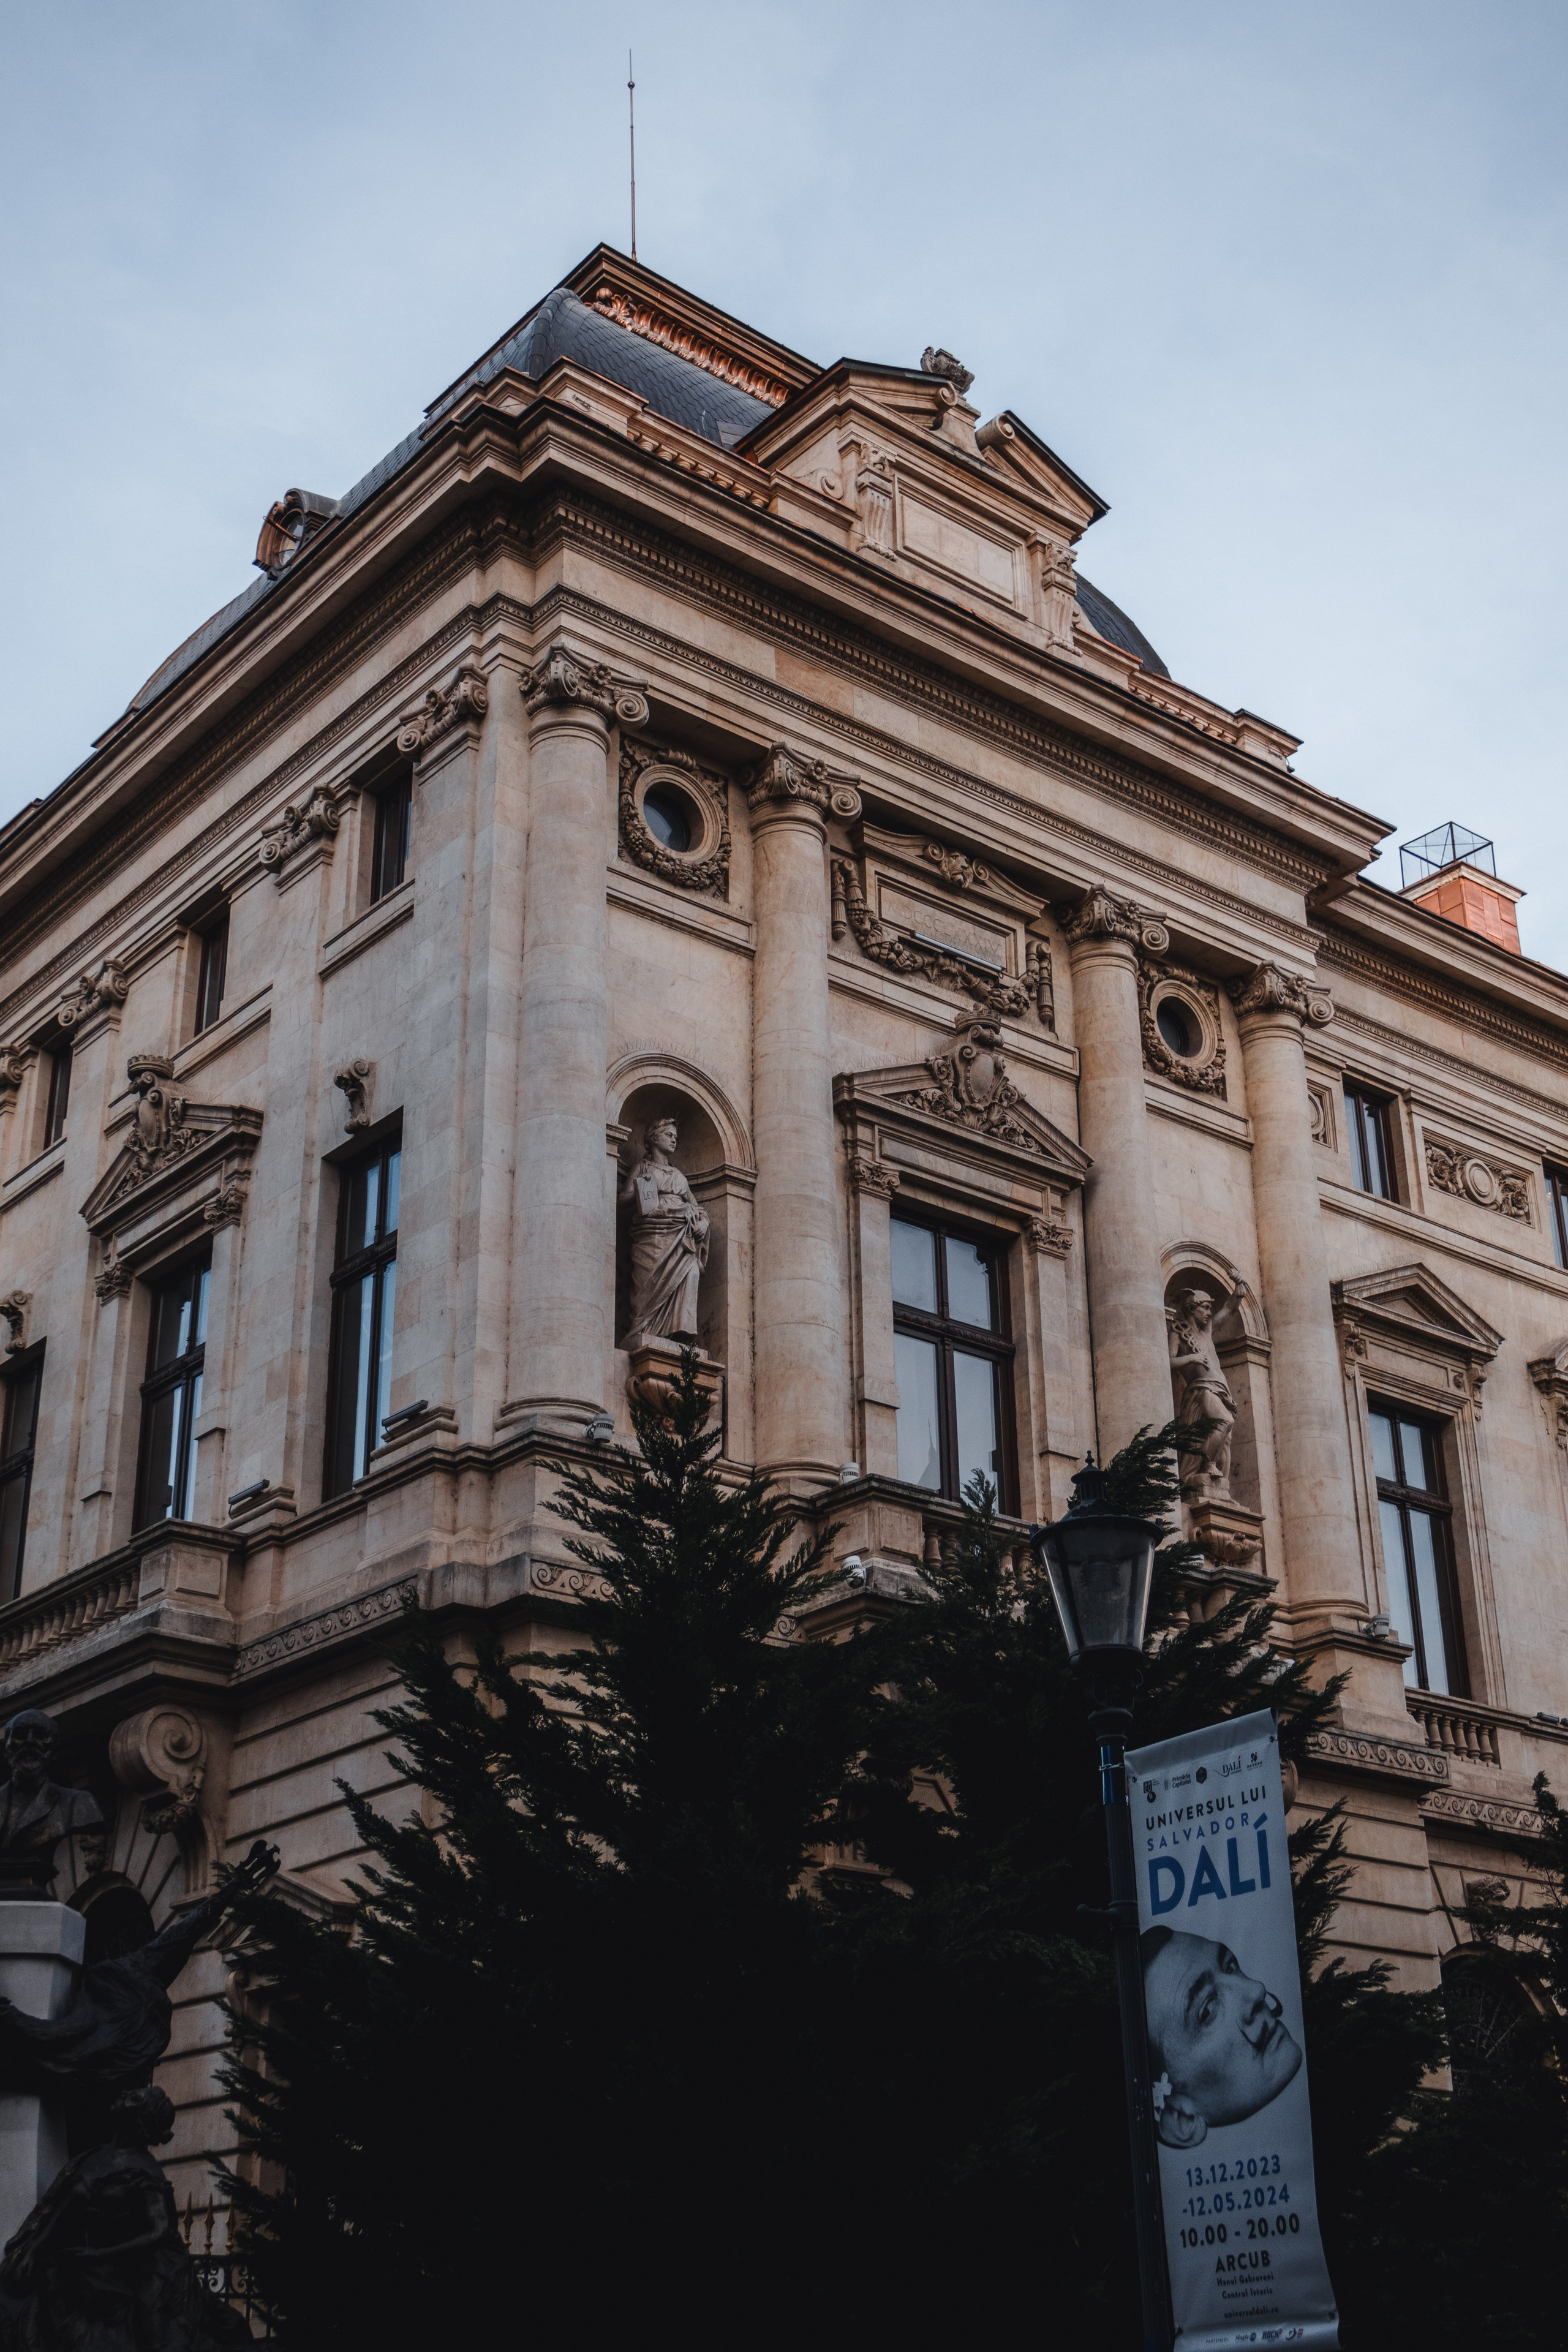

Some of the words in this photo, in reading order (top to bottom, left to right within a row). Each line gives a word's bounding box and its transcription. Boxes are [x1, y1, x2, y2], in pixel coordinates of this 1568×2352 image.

[643, 1191, 655, 1200] LEX
[1146, 1795, 1234, 1831] UNIVERSUL
[1241, 1785, 1267, 1805] LUI
[1147, 1812, 1249, 1852] SALVADOR
[1148, 1812, 1271, 1916] DALÍ
[1186, 2154, 1281, 2187] 13.12.2023
[1182, 2183, 1290, 2217] -12.05.2024
[1180, 2223, 1227, 2248] 10.00
[1246, 2212, 1300, 2239] 20.00
[1215, 2250, 1270, 2273] ARCUB
[1217, 2276, 1237, 2286] Hanul
[1239, 2271, 1274, 2284] Gabroveni
[1222, 2289, 1248, 2299] Centrul
[1250, 2286, 1273, 2296] Istoric
